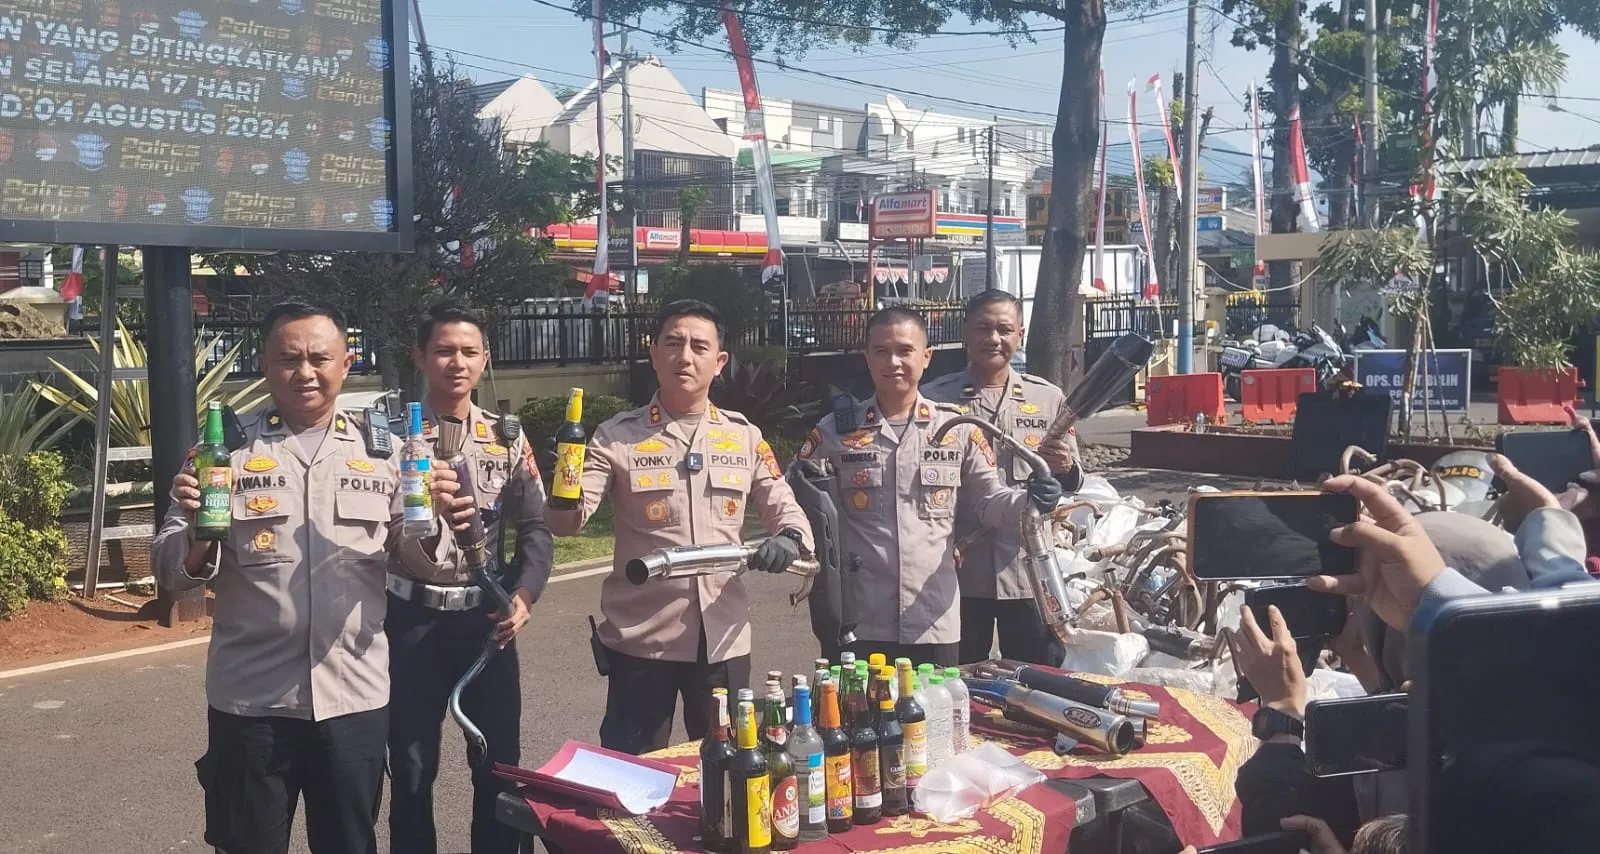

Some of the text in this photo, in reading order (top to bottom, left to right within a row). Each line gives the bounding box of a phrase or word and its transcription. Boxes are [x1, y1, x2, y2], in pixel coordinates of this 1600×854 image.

[35, 20, 120, 52] YANG
[129, 34, 341, 80] DITINGKATKAN)
[24, 57, 150, 91] SELAMA
[161, 73, 188, 94] 17
[196, 78, 261, 102] HARI
[34, 97, 74, 122] 04
[83, 101, 216, 136] AGUSTUS
[226, 115, 290, 140] 2024
[879, 196, 928, 209] Alfamart
[649, 231, 678, 242] Alfamart
[1366, 374, 1391, 387] OPS.
[1016, 418, 1047, 430] POLRI
[633, 455, 672, 467] YONKY
[711, 455, 748, 467] POLRI
[924, 450, 960, 461] POLRI
[480, 459, 511, 472] POLR
[340, 477, 386, 494] POLRI
